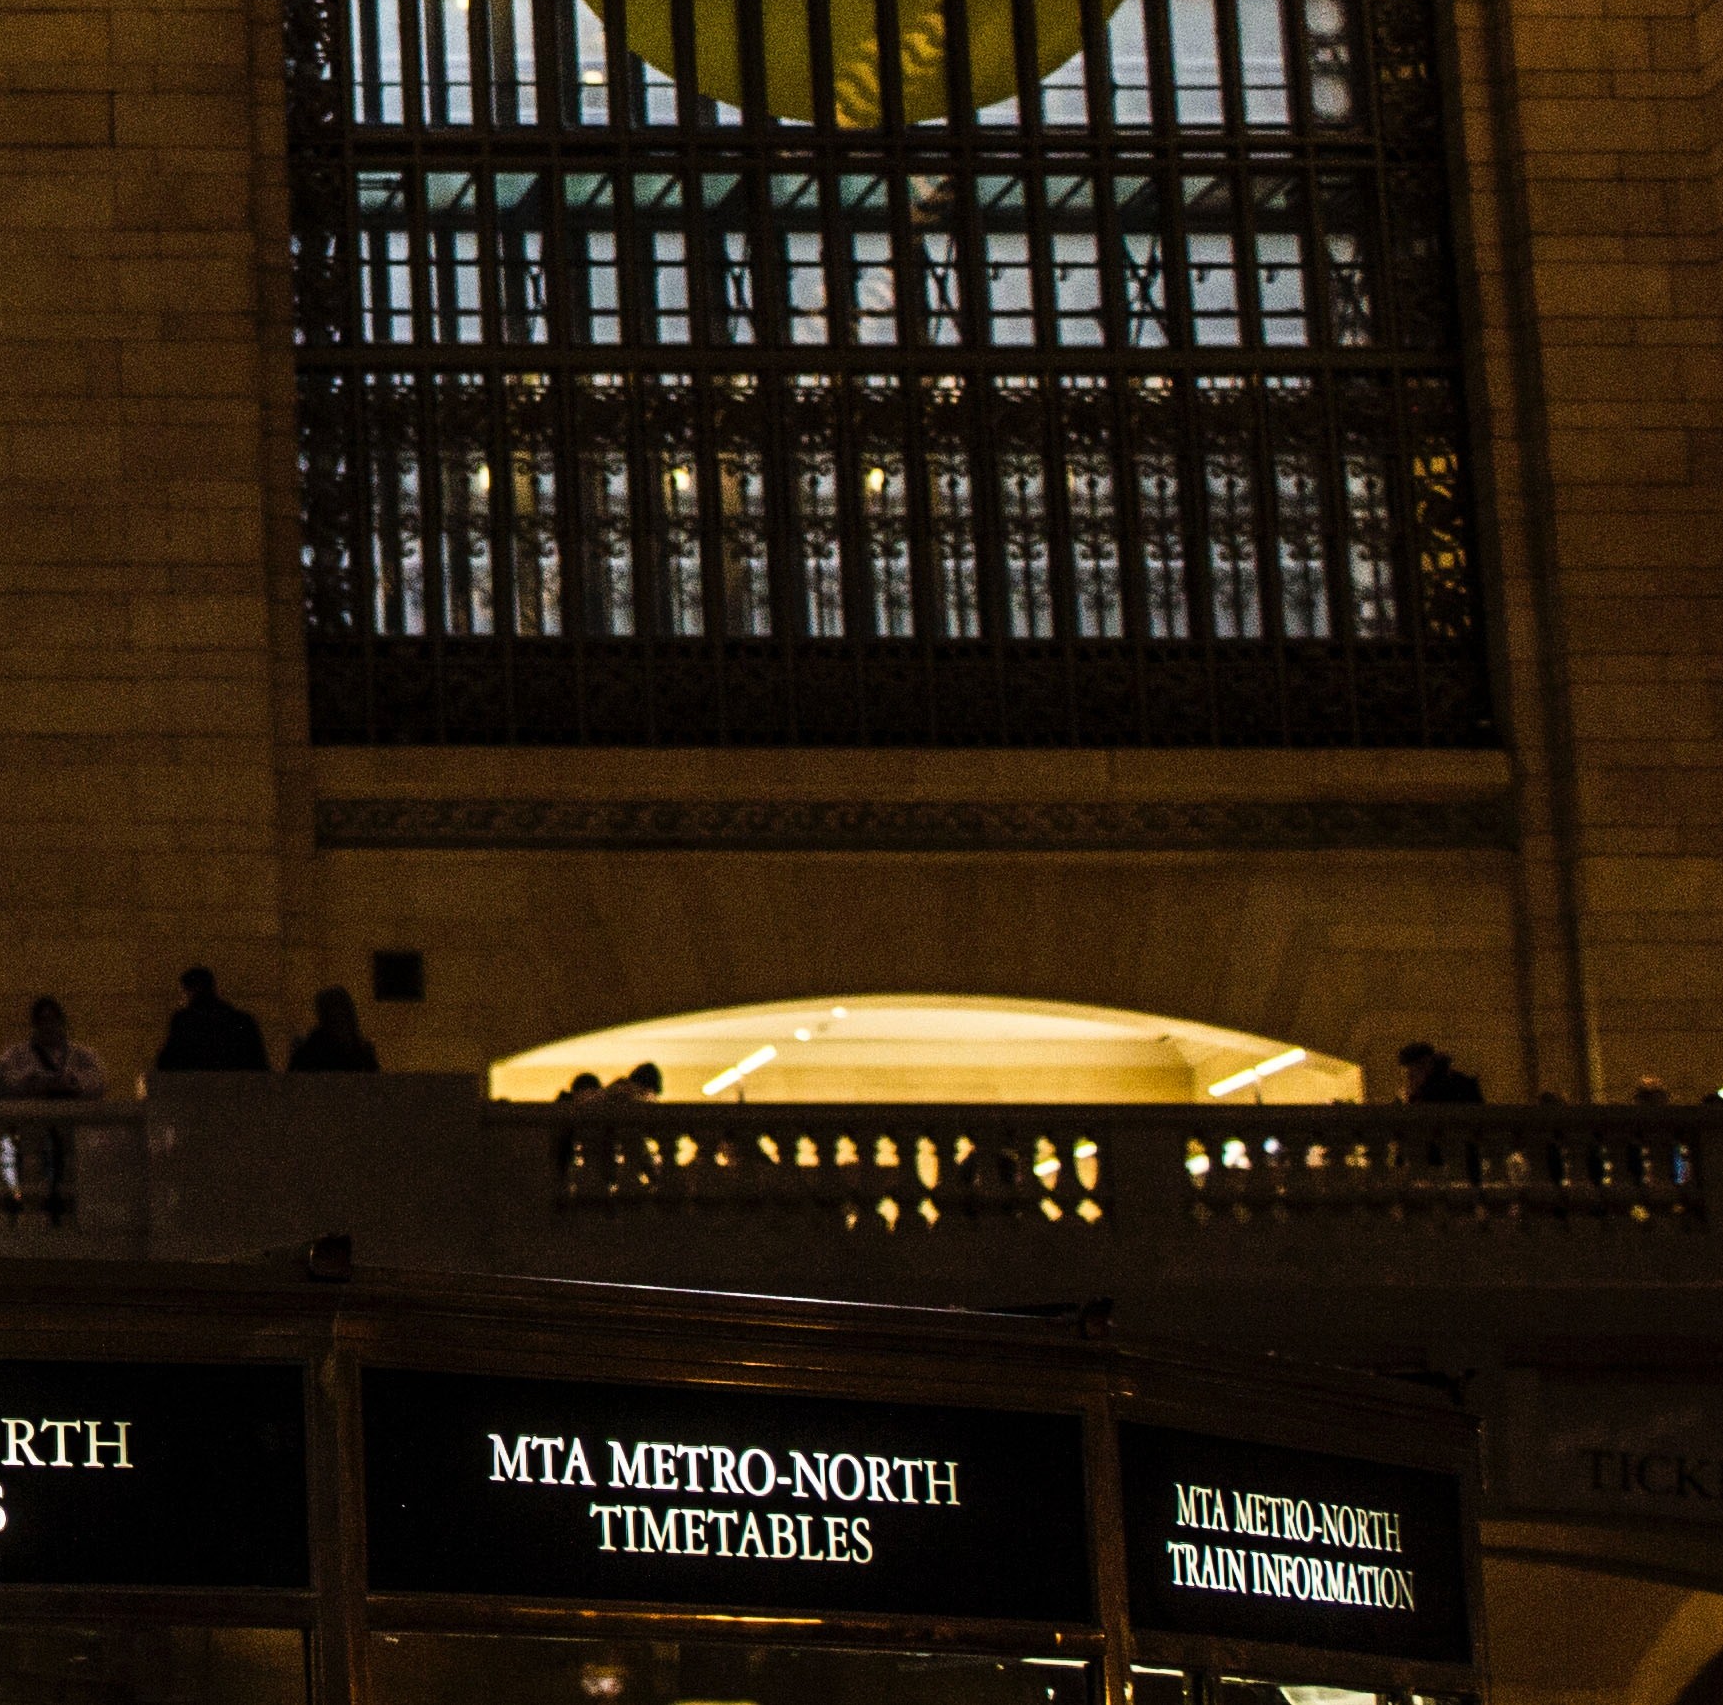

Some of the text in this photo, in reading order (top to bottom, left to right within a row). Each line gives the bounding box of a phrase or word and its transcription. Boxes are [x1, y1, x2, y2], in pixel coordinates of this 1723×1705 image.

[487, 1433, 961, 1506] MTA METRO-NORTH
[1579, 1442, 1723, 1499] TICK
[588, 1501, 874, 1564] TIMETABLES
[1175, 1482, 1403, 1553] MTA METRO-NORTH
[1166, 1540, 1415, 1612] TRAIN INFORMATION
